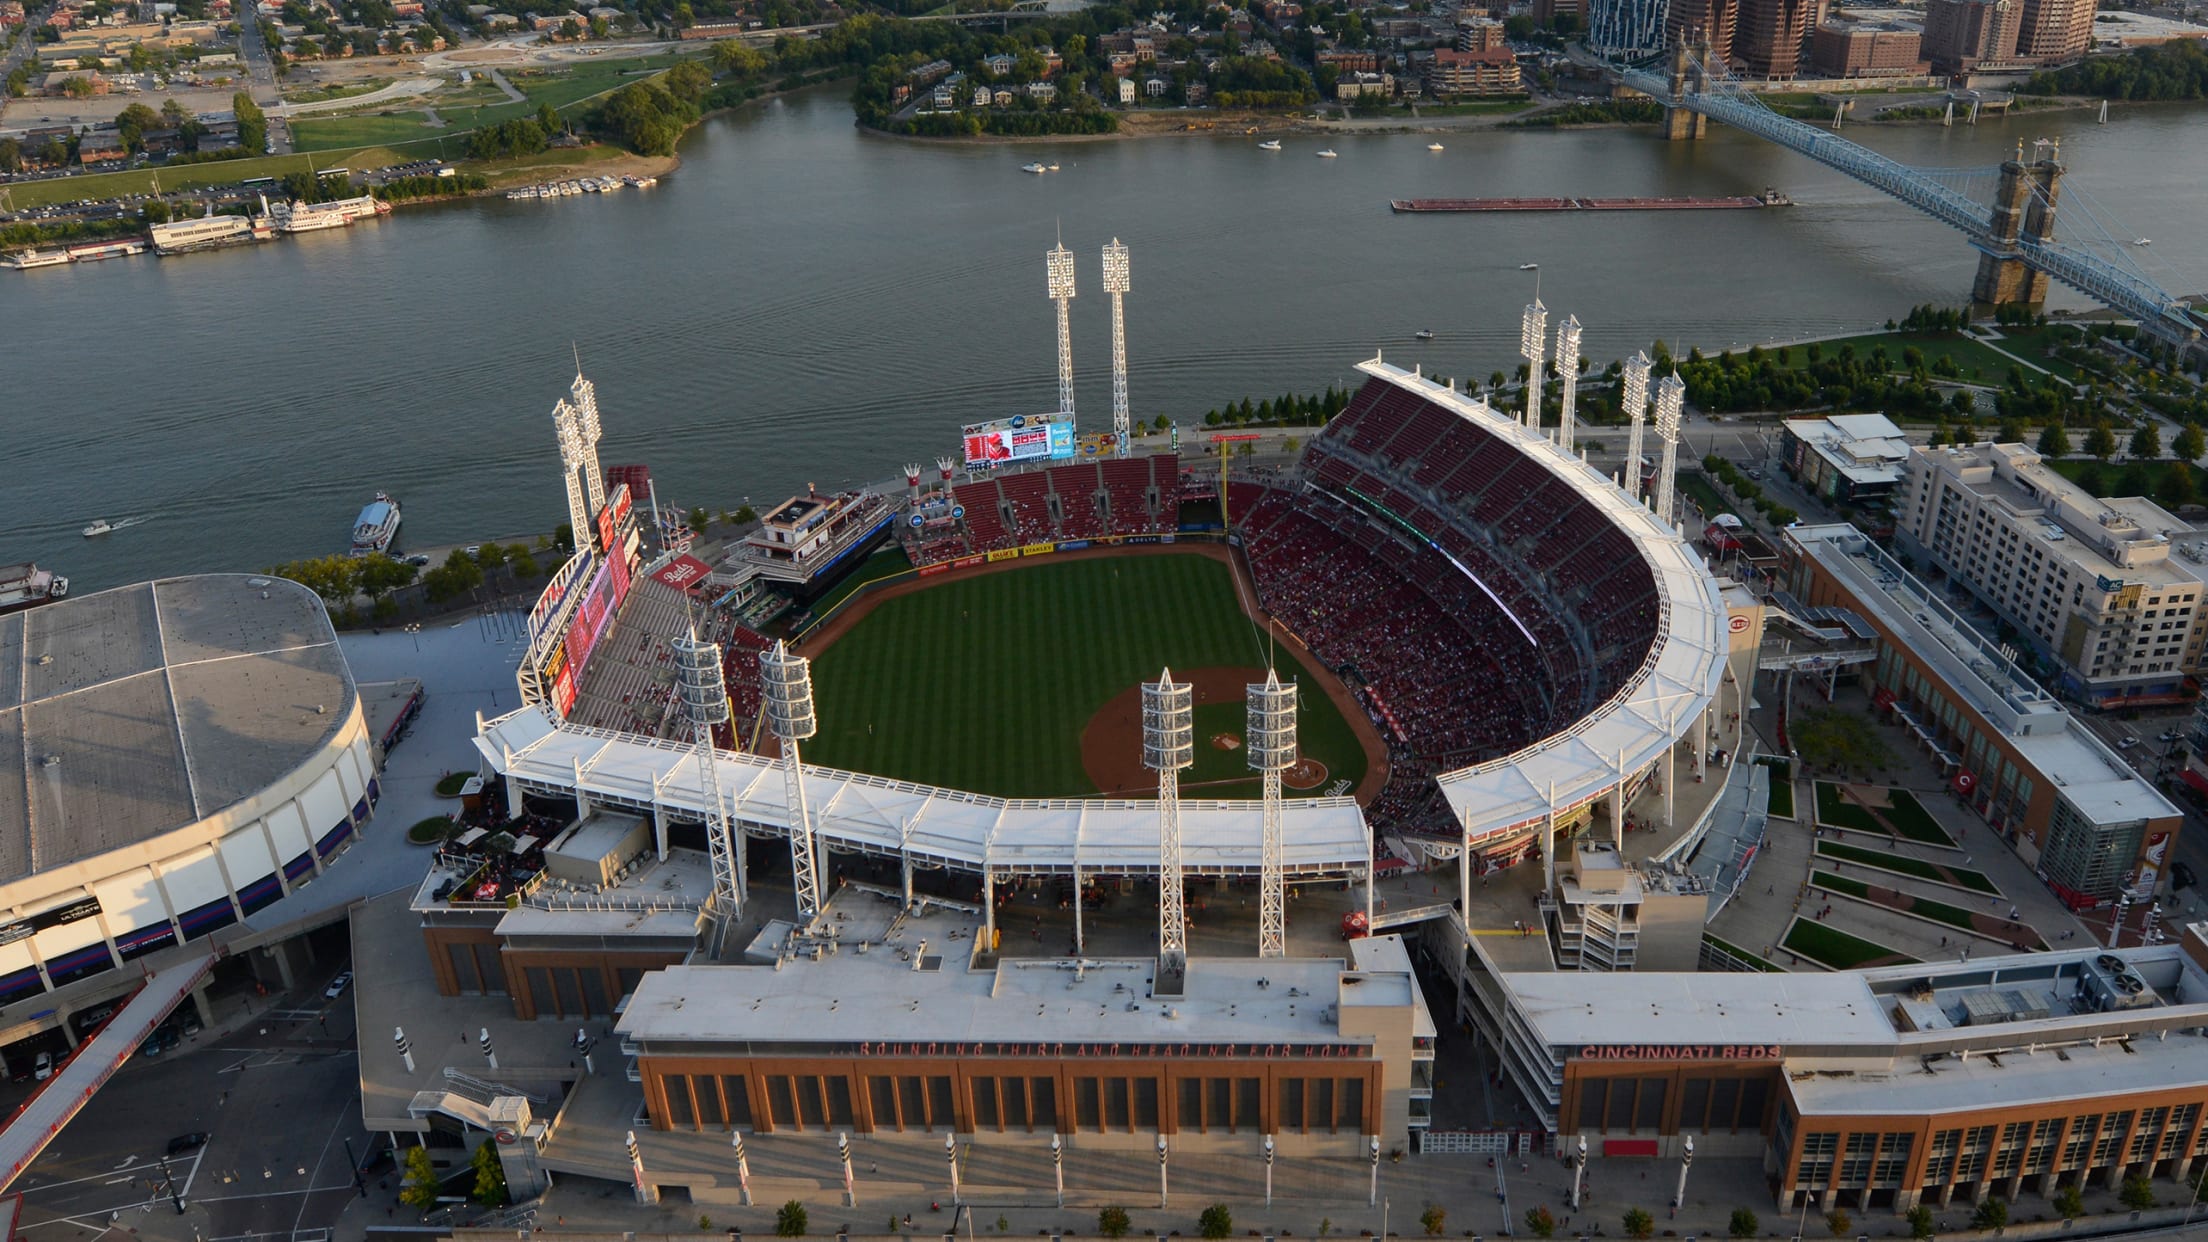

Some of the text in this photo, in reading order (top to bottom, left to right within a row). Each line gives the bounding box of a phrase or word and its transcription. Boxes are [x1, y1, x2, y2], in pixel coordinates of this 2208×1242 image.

[663, 563, 694, 583] Reds
[996, 1042, 1063, 1057] THIRD
[1076, 1042, 1120, 1057] AND
[1131, 1042, 1237, 1057] HEADING
[1250, 1042, 1292, 1057] FOR
[1304, 1042, 1367, 1057] HOME
[1581, 1045, 1782, 1059] CINCINNATI REDS
